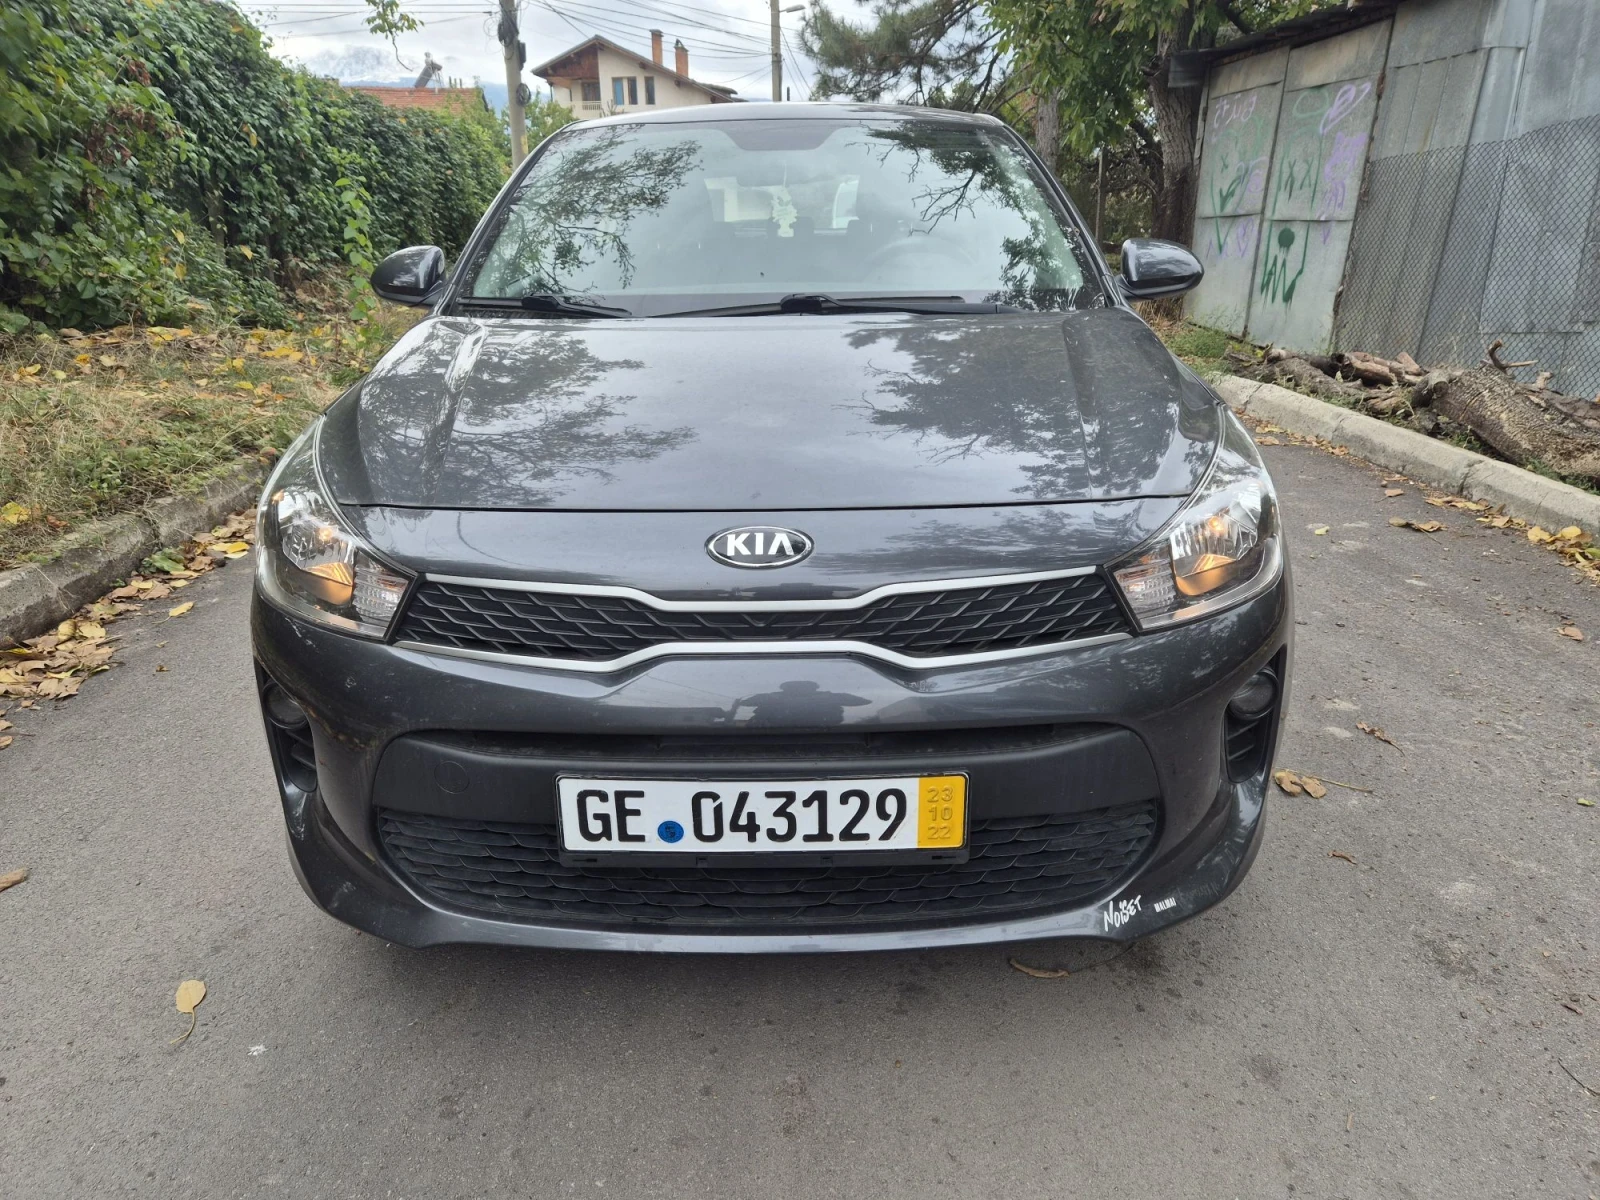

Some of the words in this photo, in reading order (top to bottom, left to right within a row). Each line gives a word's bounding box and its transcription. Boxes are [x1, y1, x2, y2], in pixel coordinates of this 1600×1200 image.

[726, 532, 795, 556] KIA
[927, 786, 954, 803] 23
[576, 789, 646, 843] GE
[691, 788, 907, 843] 043129
[928, 804, 953, 821] 10
[927, 823, 951, 840] 22
